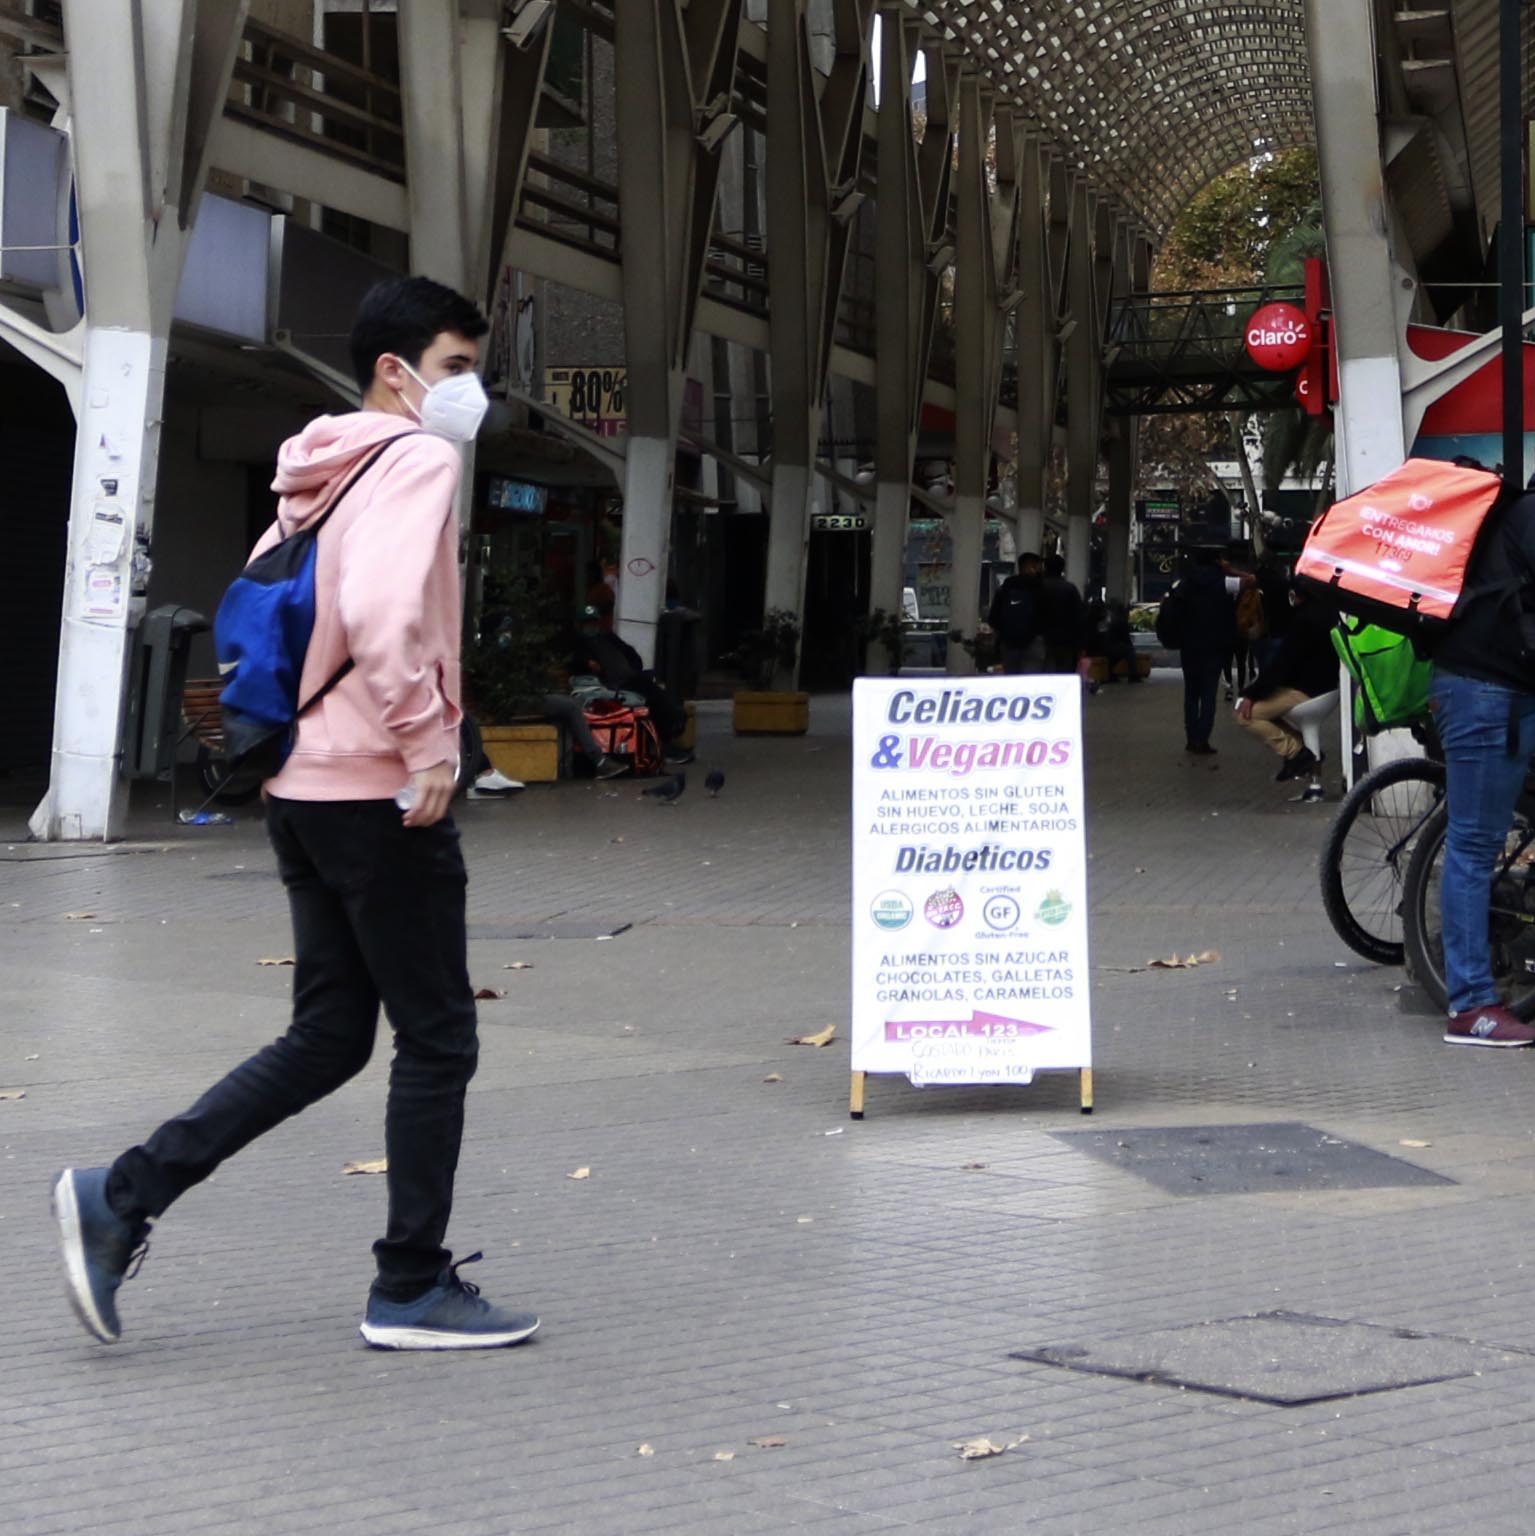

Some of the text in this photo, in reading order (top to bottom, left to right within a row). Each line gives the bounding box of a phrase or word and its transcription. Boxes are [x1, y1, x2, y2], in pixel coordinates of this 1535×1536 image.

[1248, 328, 1297, 346] Claro
[569, 370, 623, 414] 80%
[818, 518, 864, 529] 2230
[1362, 524, 1394, 543] CON
[888, 690, 1053, 724] Celiacos
[881, 785, 1064, 801] ALIMENTOS SIN GLUTEN
[877, 806, 901, 819] SIN
[907, 805, 964, 819] HUEVO,
[1029, 802, 1069, 815] SOJA
[870, 818, 1077, 835] ALERGICOS ALIMENTARIOS
[895, 845, 1052, 873] Diabeticos
[990, 906, 1012, 919] GF
[880, 951, 1069, 967] ALIMENTOS SIN AZUCAR
[876, 969, 1073, 984] CHOCOLATES, GALLETAS
[876, 987, 1074, 1002] GRANOLAS, CARAMELOS
[896, 1024, 1018, 1039] LOCAL 123
